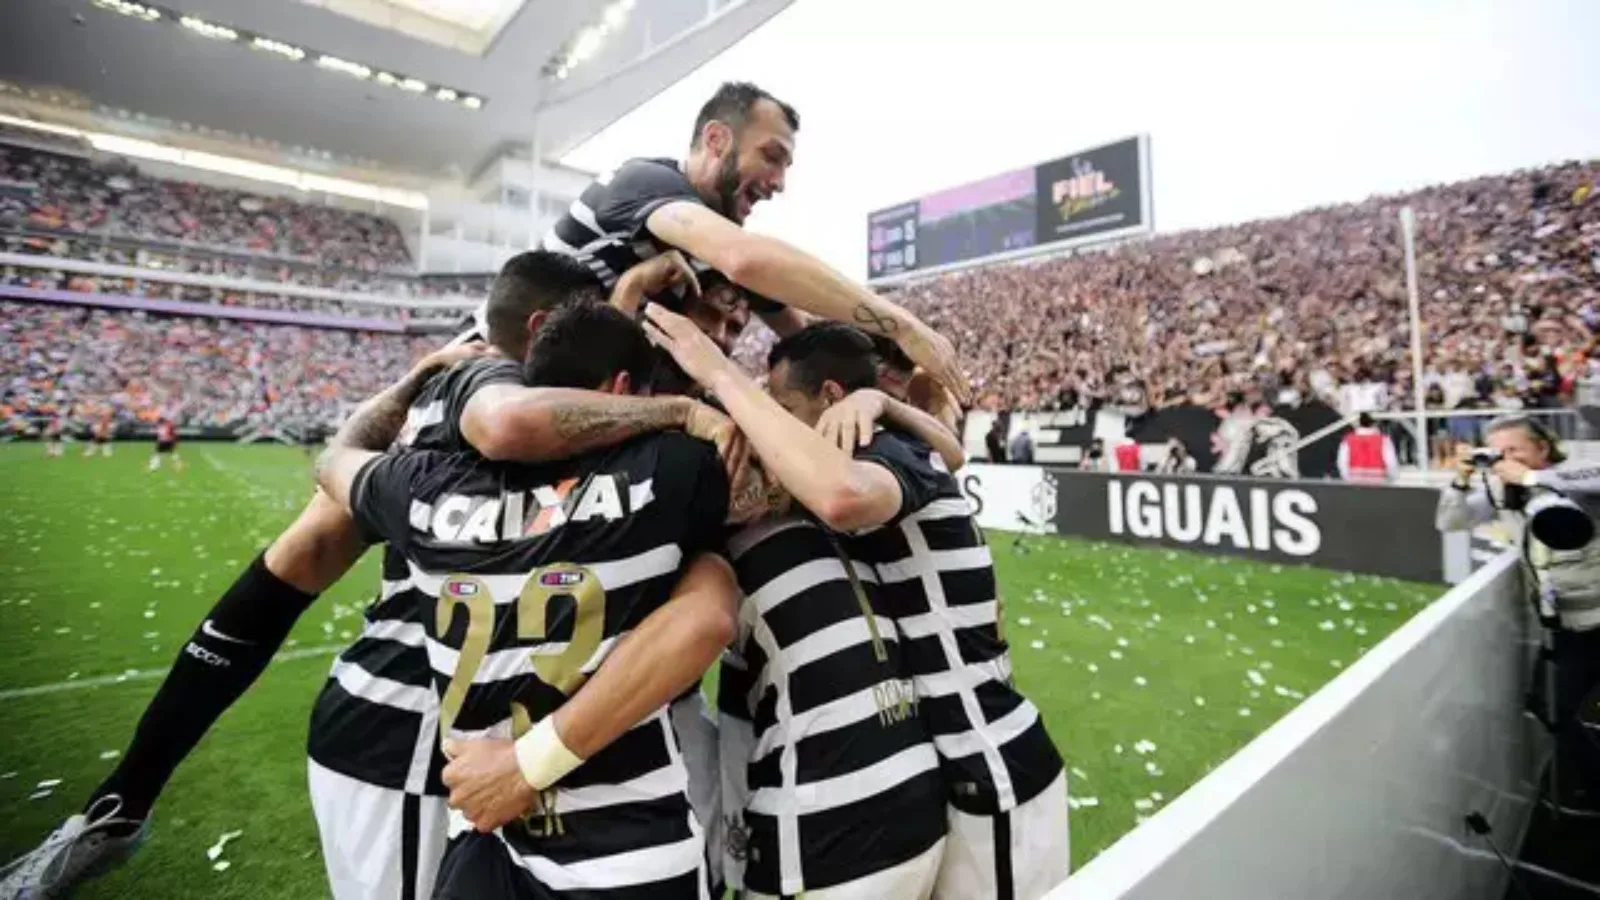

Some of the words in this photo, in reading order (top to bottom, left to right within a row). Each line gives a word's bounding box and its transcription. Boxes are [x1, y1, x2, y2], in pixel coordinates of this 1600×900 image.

[431, 474, 624, 542] CAIXA
[1107, 480, 1321, 556] IGUAIS
[436, 562, 606, 755] 23
